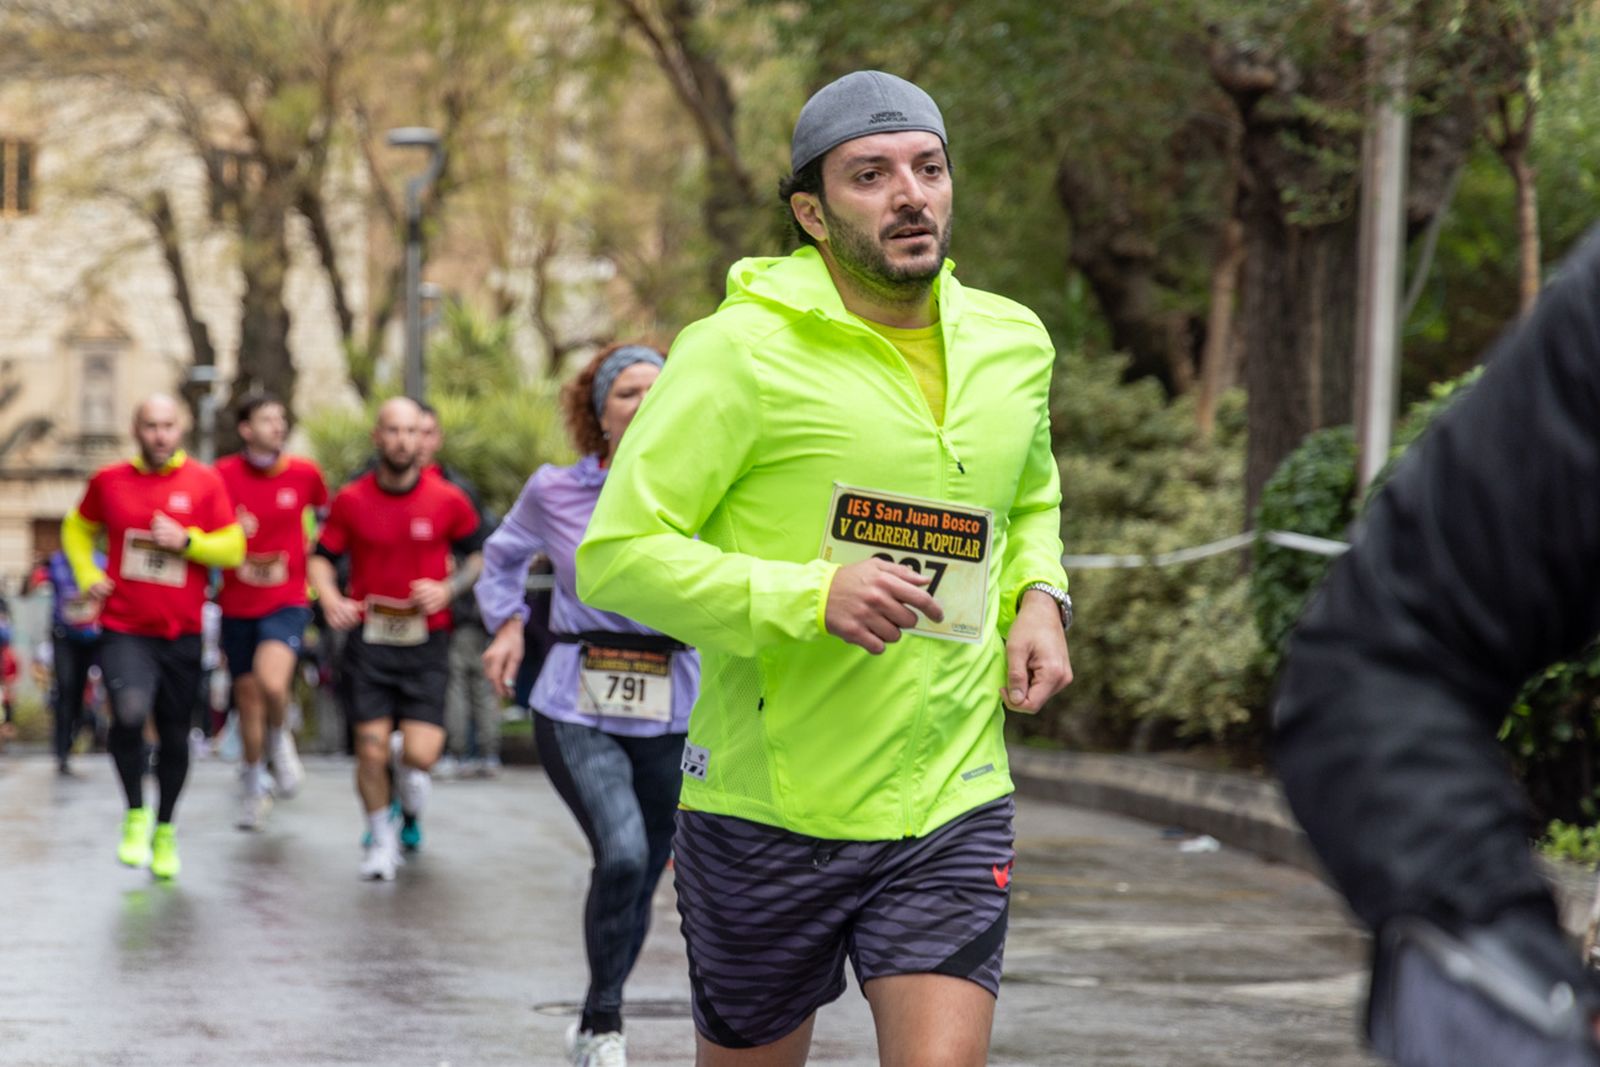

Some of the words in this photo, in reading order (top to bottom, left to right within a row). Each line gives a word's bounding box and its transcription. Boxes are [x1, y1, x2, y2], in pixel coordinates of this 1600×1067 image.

[847, 498, 871, 518] IES
[875, 503, 902, 523] San
[905, 507, 938, 528] Juan
[942, 513, 980, 534] Bosco
[839, 518, 852, 536] V
[854, 521, 919, 549] CARRERA
[922, 532, 981, 558] POPULAR
[606, 675, 645, 702] 791
